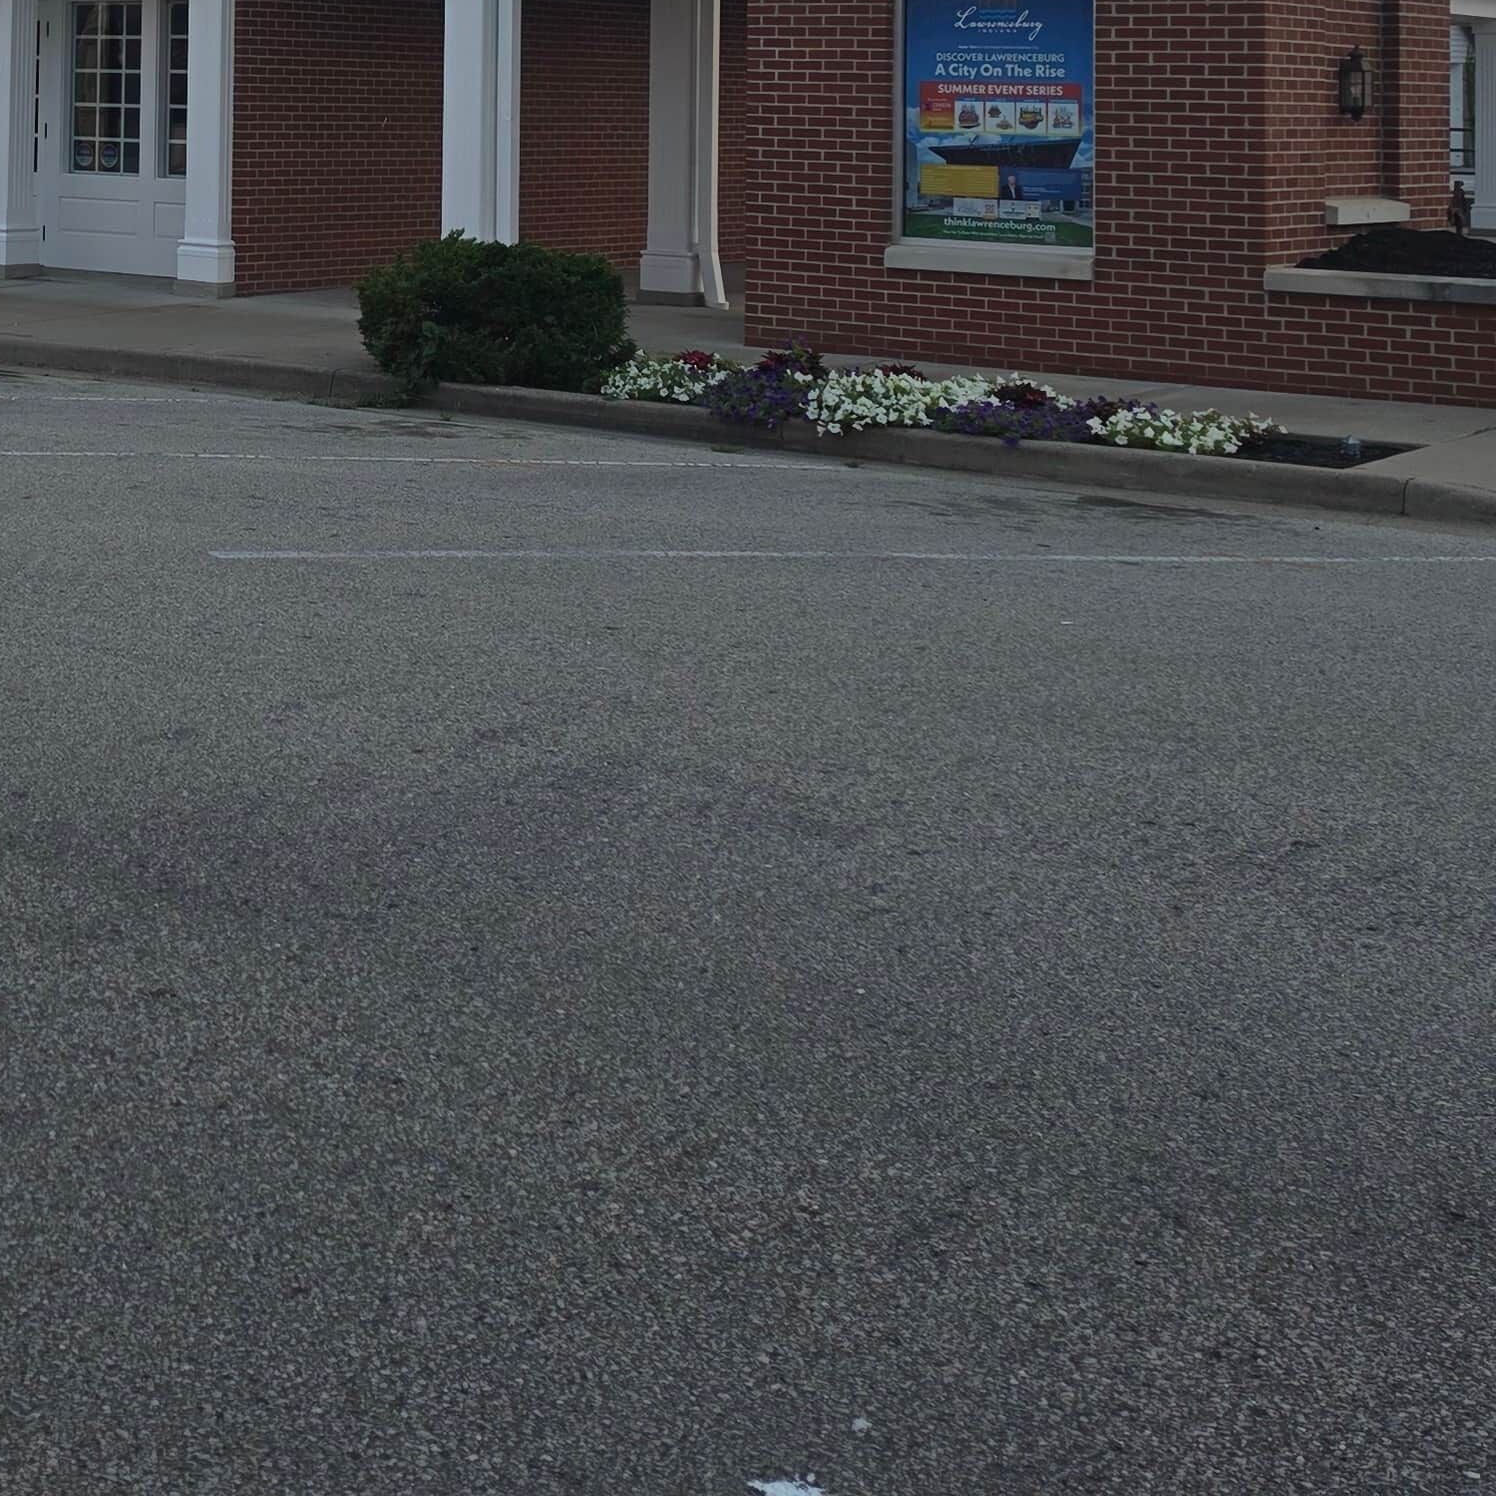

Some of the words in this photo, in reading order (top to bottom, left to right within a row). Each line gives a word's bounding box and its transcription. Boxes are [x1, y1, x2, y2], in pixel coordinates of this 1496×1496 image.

[954, 6, 1043, 41] Lawrenceburg
[936, 52, 984, 62] DISCOVER
[985, 53, 1065, 63] LAWRENCEBURG
[935, 64, 945, 76] A
[949, 64, 977, 80] City
[981, 64, 1002, 77] On
[1005, 64, 1032, 77] The
[1036, 65, 1066, 78] Rise
[938, 83, 986, 95] SUMMER
[988, 85, 1024, 96] EVENT
[1026, 86, 1064, 96] SERIES
[944, 217, 1056, 233] thinklawrenceburg.com
